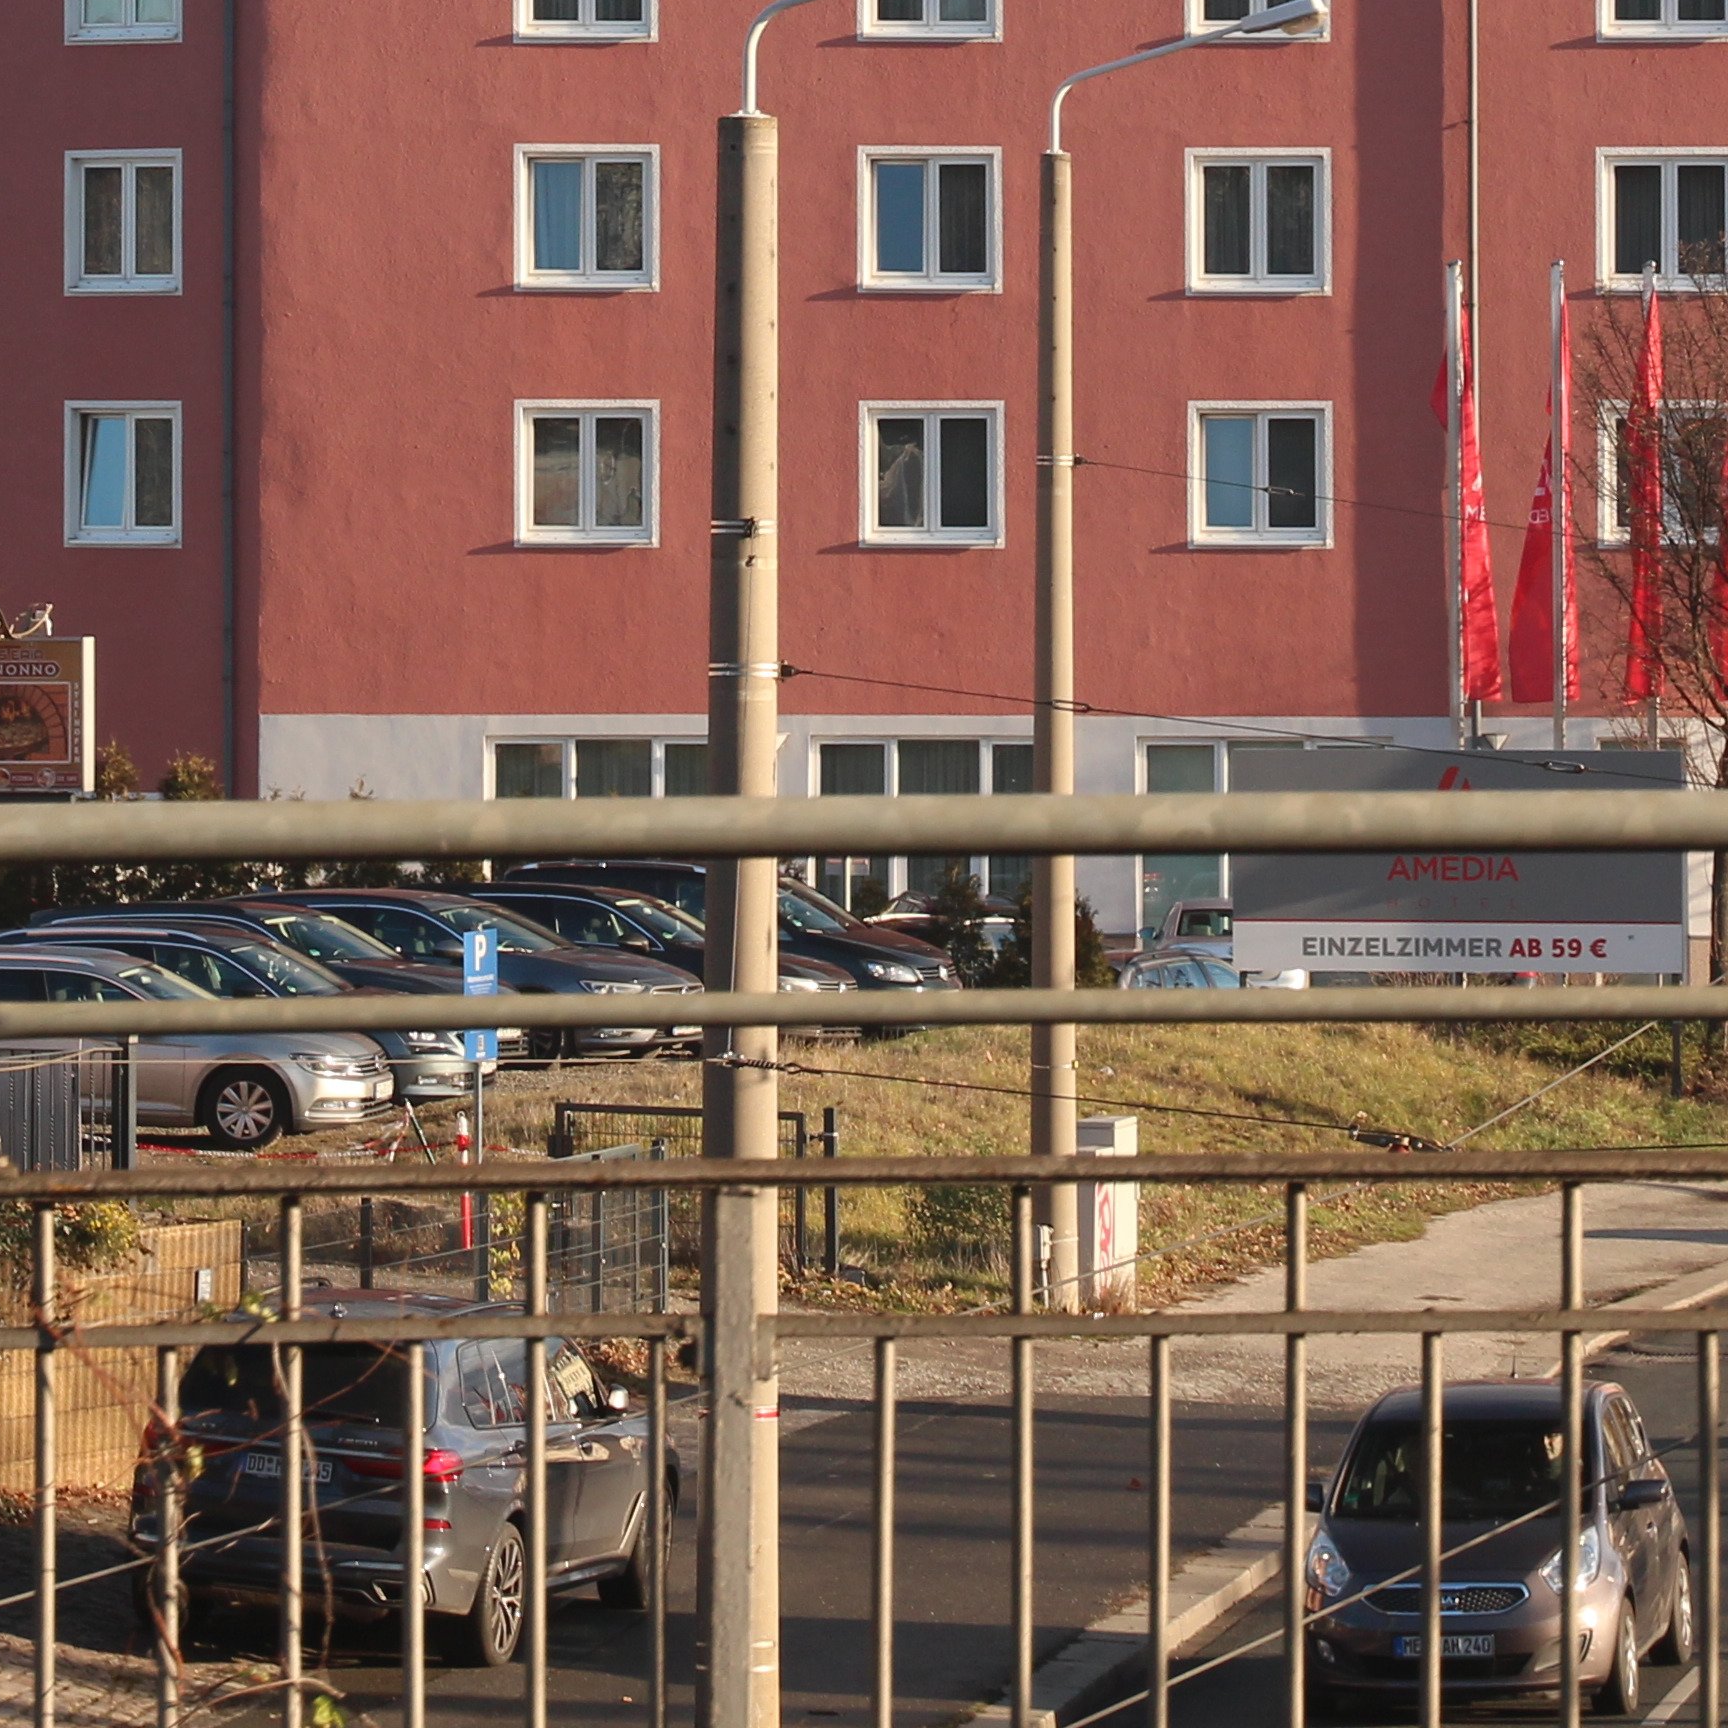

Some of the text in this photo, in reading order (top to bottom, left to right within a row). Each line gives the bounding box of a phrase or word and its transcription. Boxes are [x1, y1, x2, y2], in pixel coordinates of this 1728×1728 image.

[1386, 856, 1520, 882] AMEDIA
[1386, 896, 1520, 910] HOTEL
[1302, 936, 1608, 958] EINZELZIMMER AB 59 €
[1463, 1636, 1491, 1654] 240
